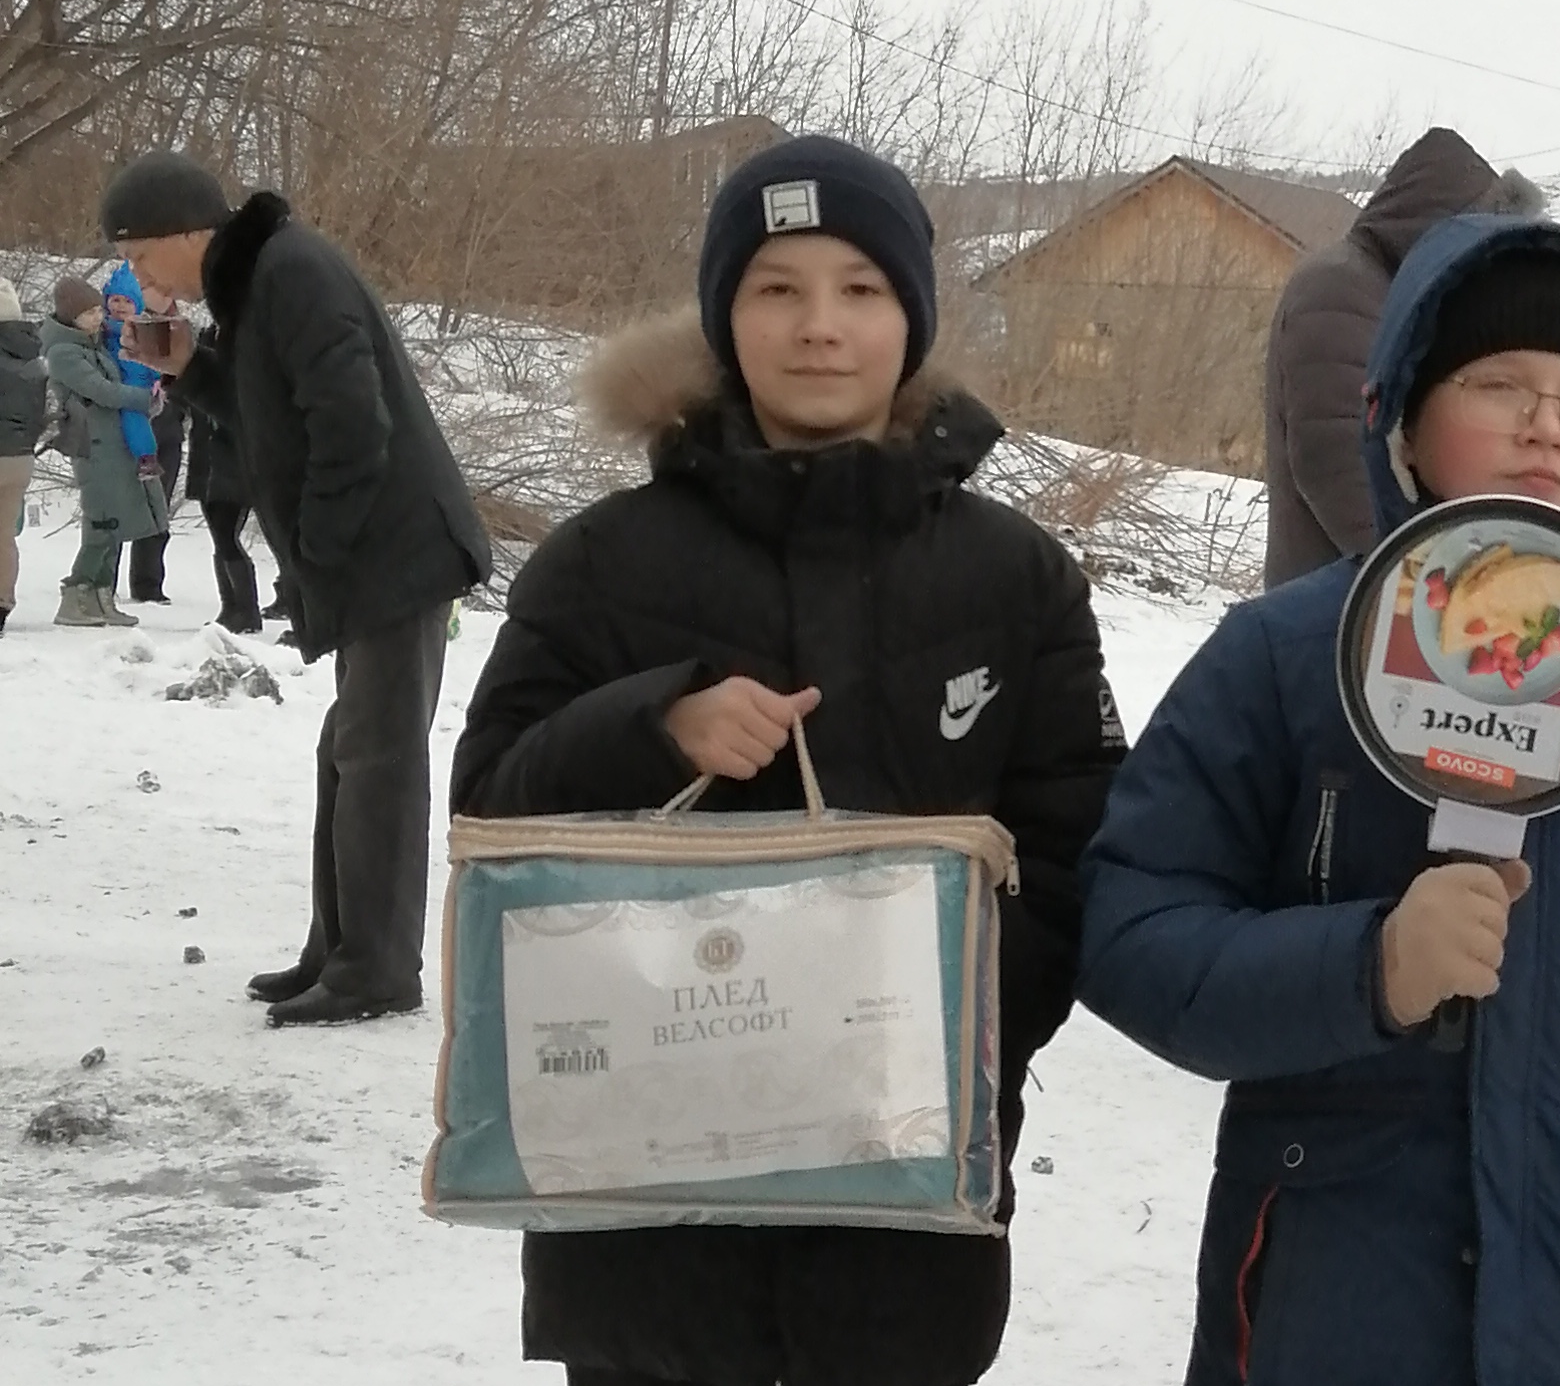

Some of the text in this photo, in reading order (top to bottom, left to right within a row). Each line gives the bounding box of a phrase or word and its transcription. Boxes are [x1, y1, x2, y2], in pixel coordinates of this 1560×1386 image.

[946, 666, 989, 713] NIKE
[1420, 707, 1538, 753] Expert
[1436, 752, 1506, 782] SCOVO
[673, 976, 770, 1013] ПЛЕД
[652, 1007, 793, 1047] ВЕЛСОФТ
